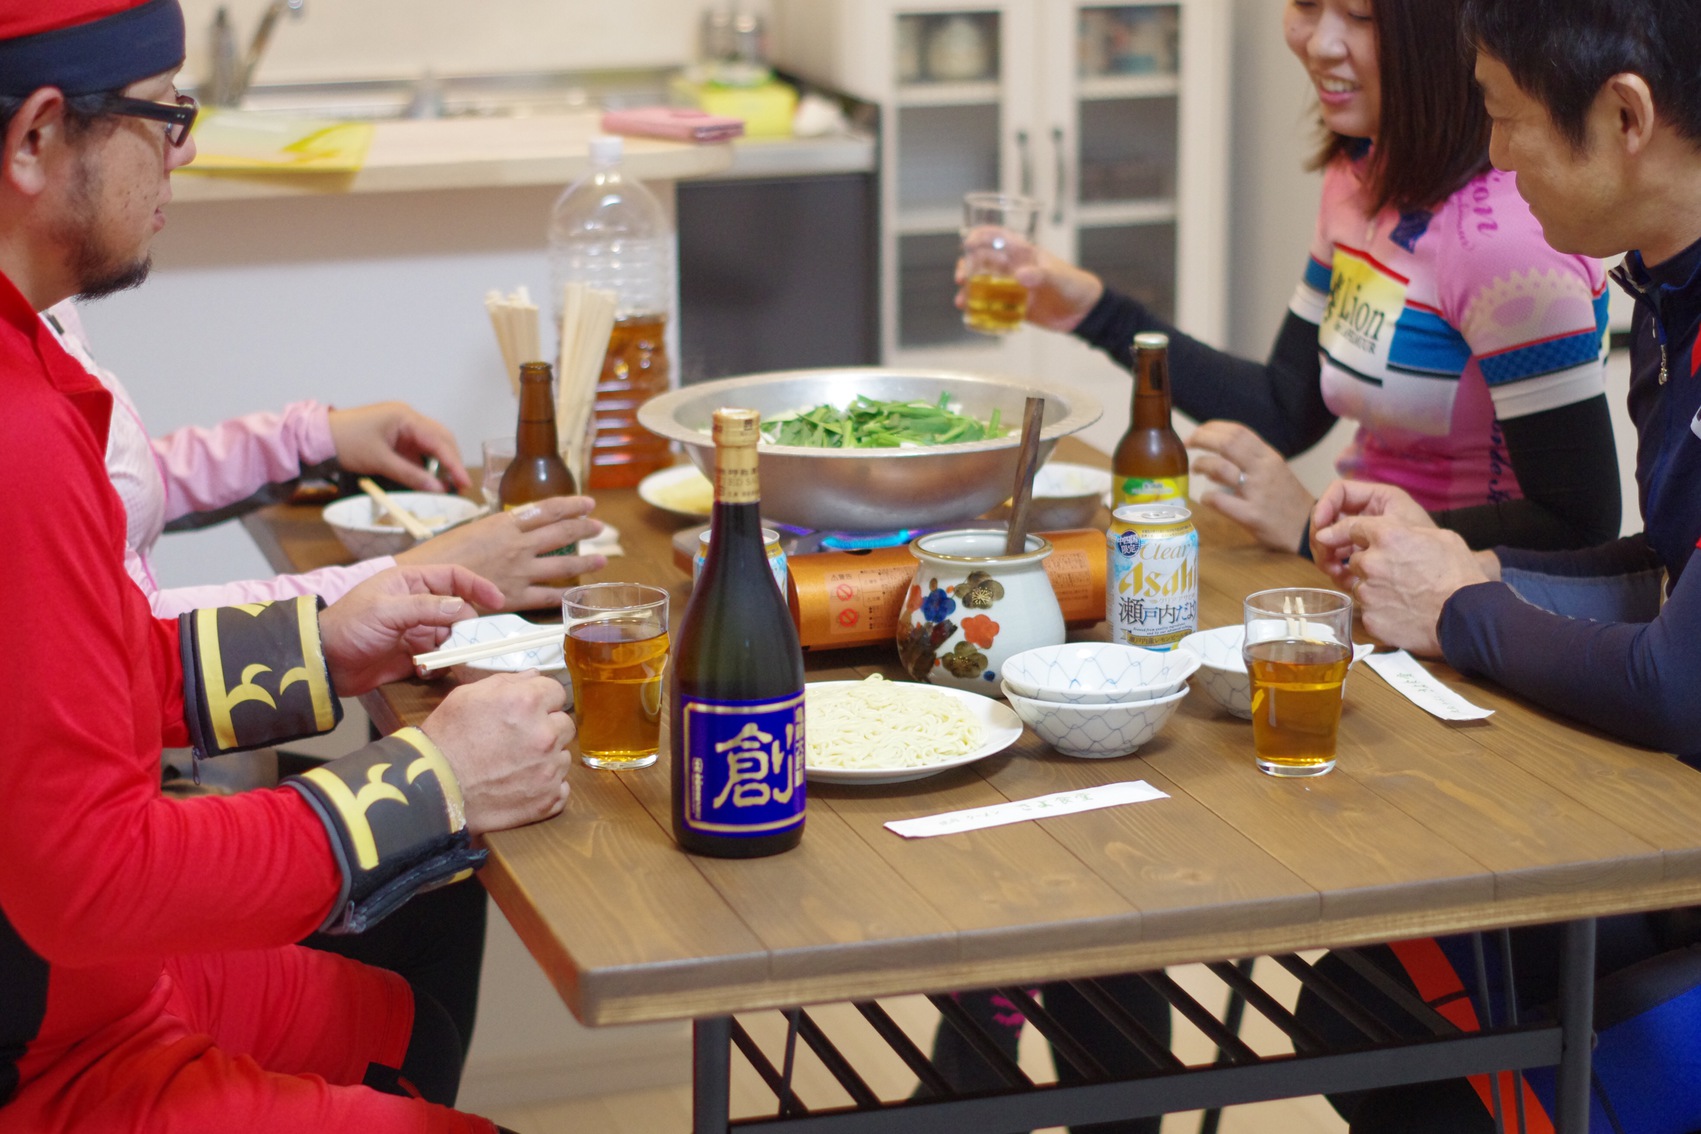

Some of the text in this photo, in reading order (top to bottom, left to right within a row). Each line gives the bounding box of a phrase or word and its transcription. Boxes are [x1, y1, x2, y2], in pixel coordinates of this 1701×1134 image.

[1339, 276, 1385, 341] Lion
[1140, 542, 1191, 561] Clear
[1118, 596, 1197, 626] 瀬戸内だより
[712, 722, 794, 809] 創
